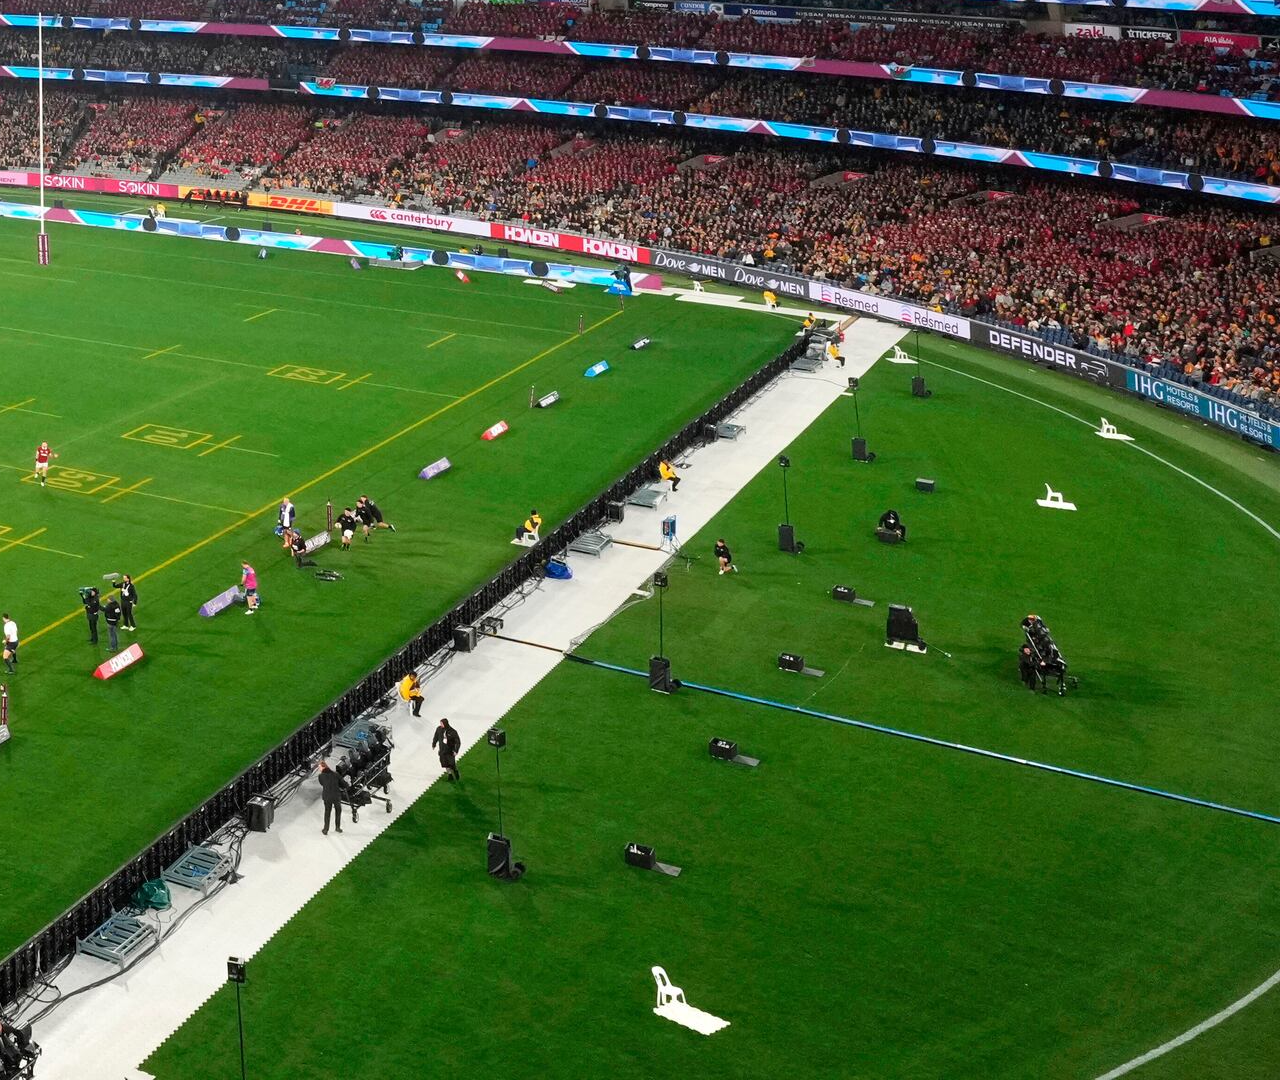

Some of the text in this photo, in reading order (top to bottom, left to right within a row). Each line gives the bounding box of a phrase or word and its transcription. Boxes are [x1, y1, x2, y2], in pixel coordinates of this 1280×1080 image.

[748, 8, 777, 16] Tasmania
[795, 10, 823, 18] NISSAN
[827, 12, 856, 20] NISSAN
[859, 14, 887, 22] NISSAN
[954, 20, 983, 28] NISSAN
[44, 174, 85, 189] SOKIN
[118, 180, 160, 195] SOKIN
[267, 196, 321, 211] DHL
[391, 210, 453, 230] canterbury
[504, 226, 559, 248] HOWDEN
[582, 238, 638, 262] HOWDEN
[654, 251, 726, 279] Dove MEN
[733, 267, 805, 296] Dove MEN
[834, 291, 879, 314] Resmed
[914, 311, 959, 335] Resmed
[990, 330, 1077, 369] DEFENDER
[1134, 373, 1163, 400] IHG
[1166, 385, 1193, 401] HOTELS
[1167, 396, 1200, 414] RESORTS
[1208, 400, 1237, 428] IHG
[1239, 413, 1267, 430] HOTELS
[1240, 424, 1273, 444] RESORTS
